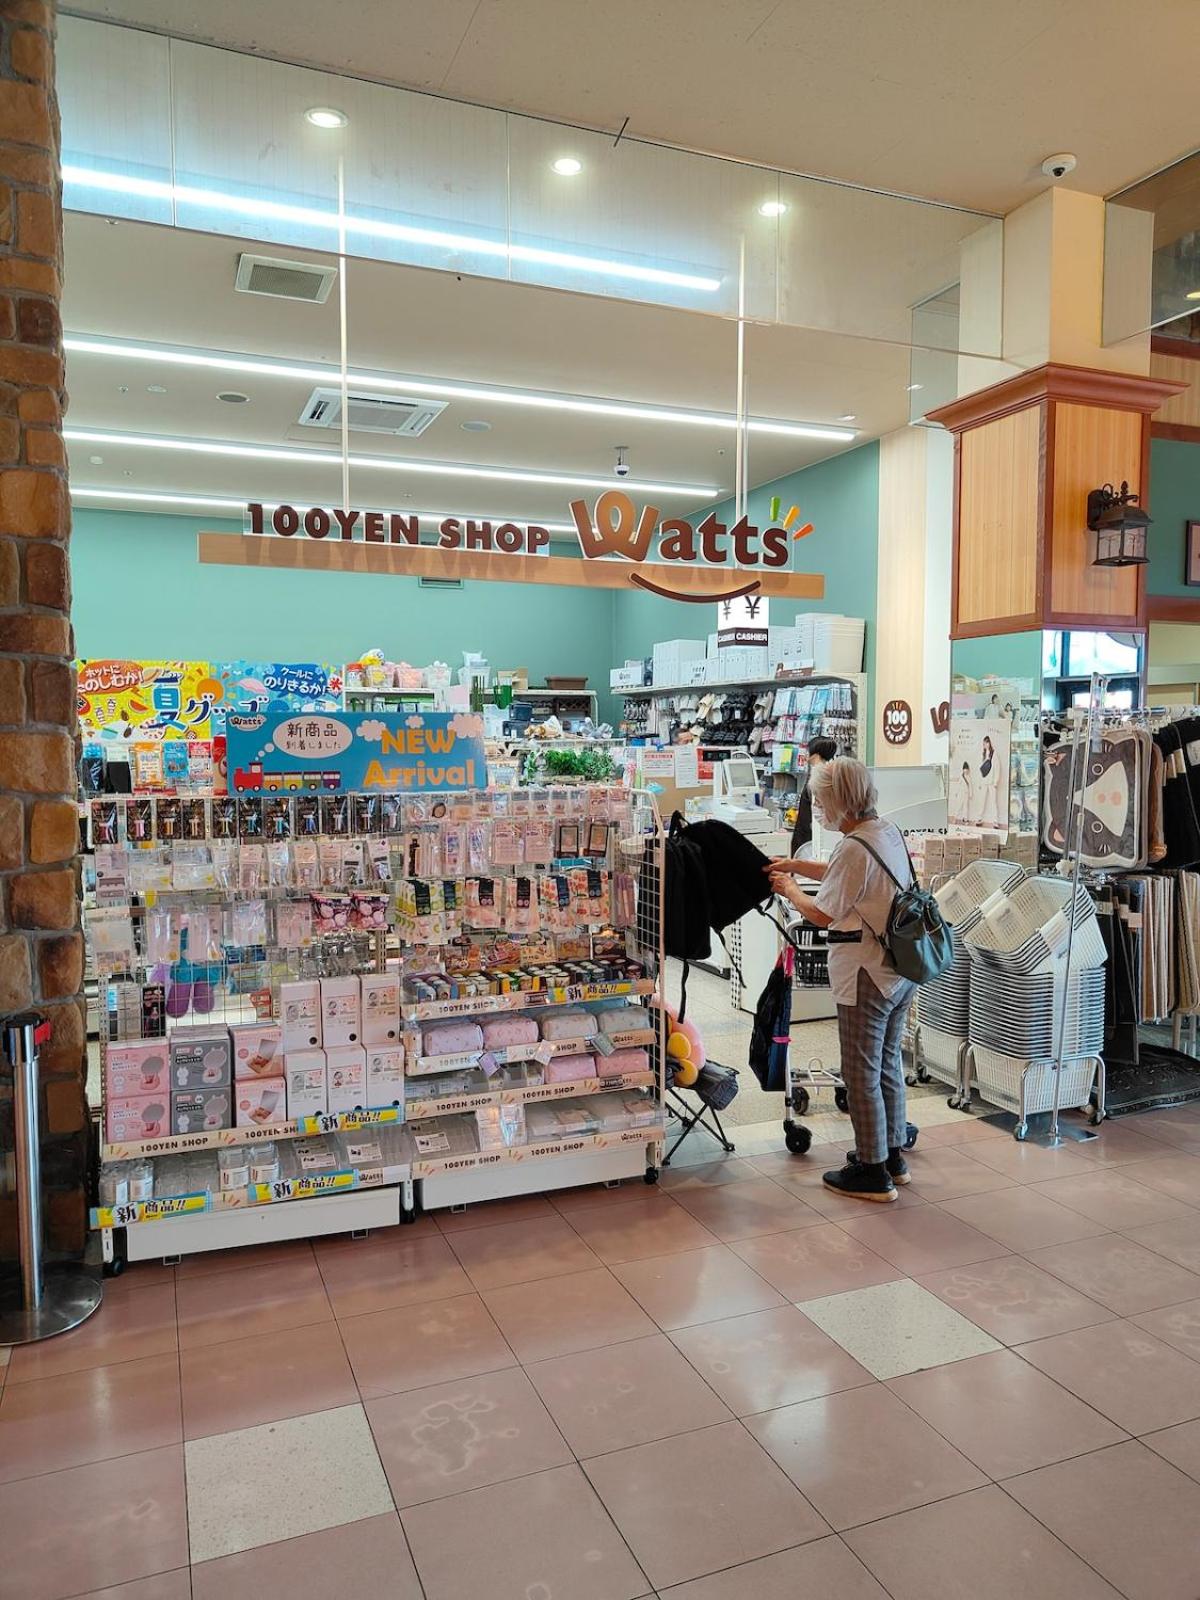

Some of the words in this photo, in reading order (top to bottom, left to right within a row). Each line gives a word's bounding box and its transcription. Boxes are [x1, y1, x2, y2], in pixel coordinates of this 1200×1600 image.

[248, 503, 419, 545] 100YEN
[439, 519, 549, 553] SHOP
[570, 490, 789, 566] Watts
[736, 632, 767, 642] CASHIER
[281, 666, 314, 680] クールに
[886, 710, 908, 725] 100
[287, 721, 338, 738] 新商品
[381, 729, 456, 754] NEW
[363, 760, 475, 789] Arrival
[556, 1043, 577, 1052] SHOP
[522, 1090, 552, 1099] 100YEN
[554, 1086, 575, 1095] SHOP
[436, 1101, 467, 1111] 100YEN
[470, 1098, 492, 1106] SHOP
[245, 1127, 280, 1139] 100YEN
[141, 1141, 178, 1152] 100YEN
[182, 1137, 208, 1148] SHOP
[531, 1146, 560, 1155] 100YEN
[563, 1142, 584, 1151] SHOP
[444, 1159, 476, 1169] 100YEN
[479, 1155, 501, 1164] SHOP
